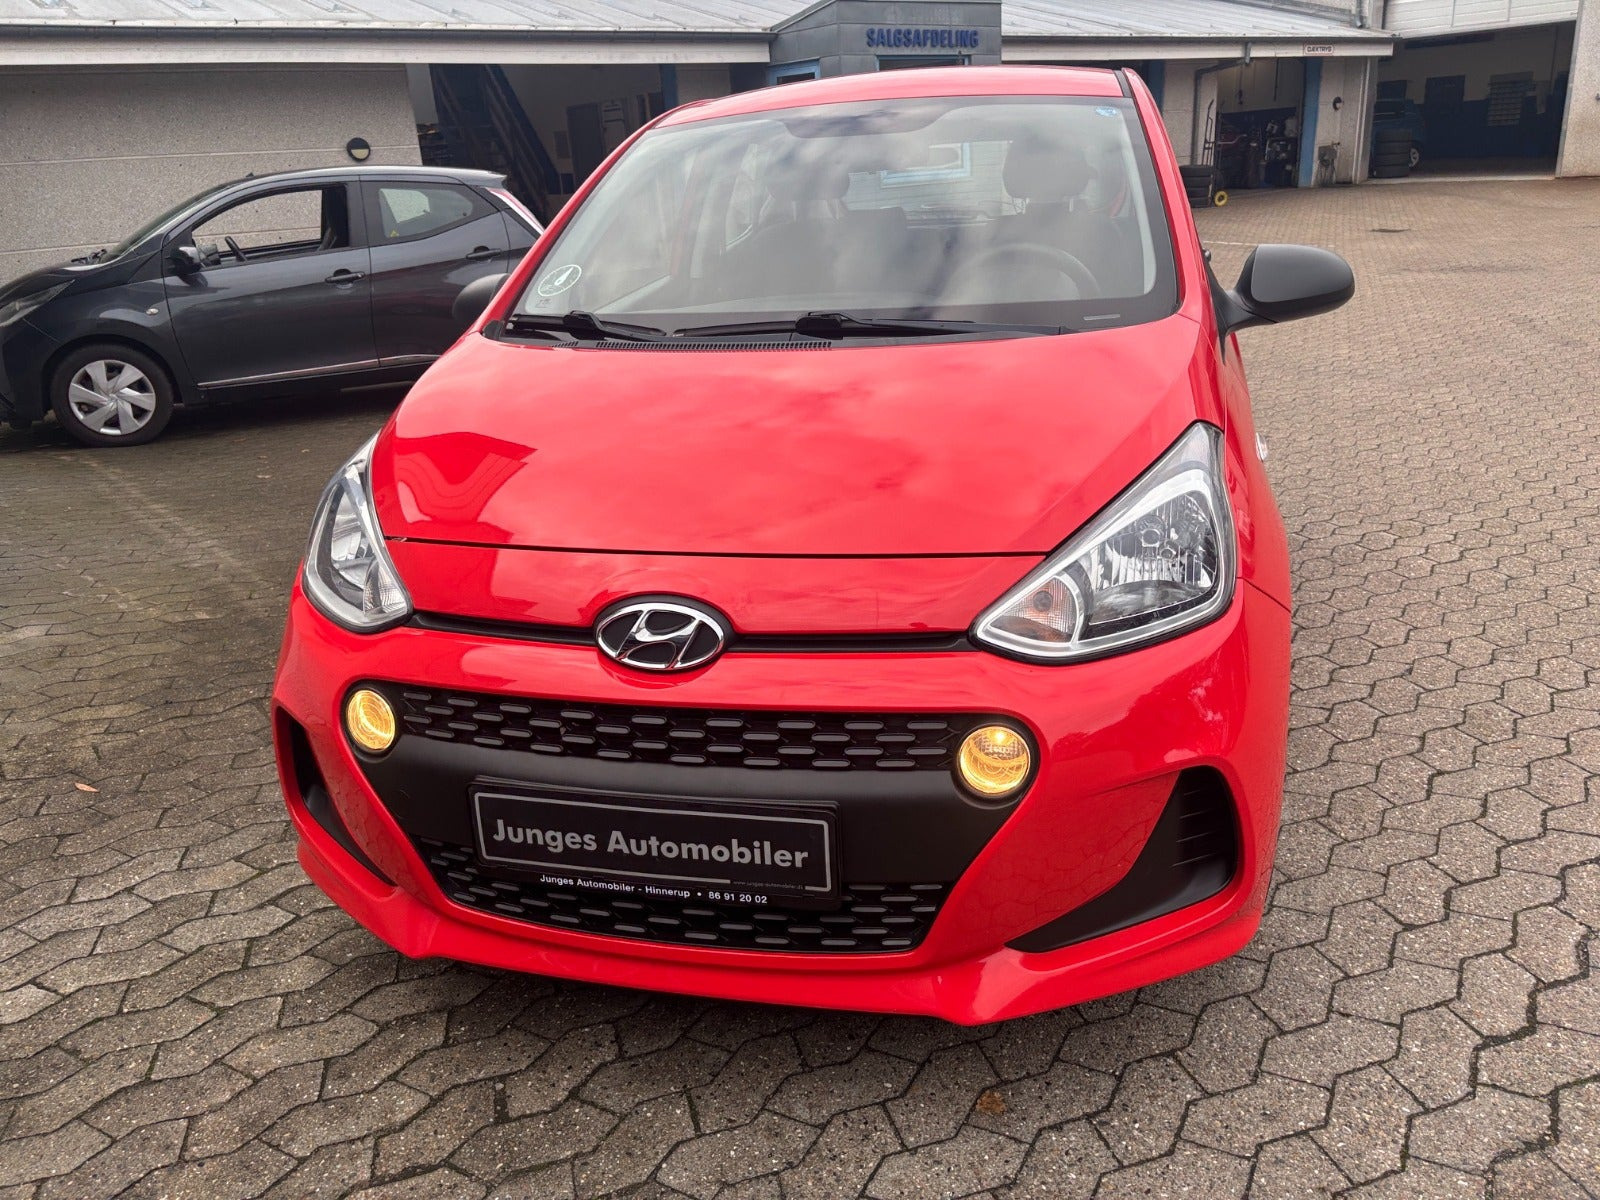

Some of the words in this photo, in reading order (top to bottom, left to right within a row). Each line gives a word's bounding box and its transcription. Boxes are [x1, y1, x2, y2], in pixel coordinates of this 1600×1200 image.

[866, 28, 979, 48] SALGSAFDELING
[493, 819, 598, 853] Junges
[607, 830, 809, 868] Automobiler
[540, 874, 574, 886] Junges
[576, 878, 635, 892] Automobiler
[645, 886, 690, 898] Hinnerup
[708, 891, 721, 900] 86
[723, 892, 735, 901] 91
[739, 893, 752, 903] 20
[754, 895, 768, 904] 02
